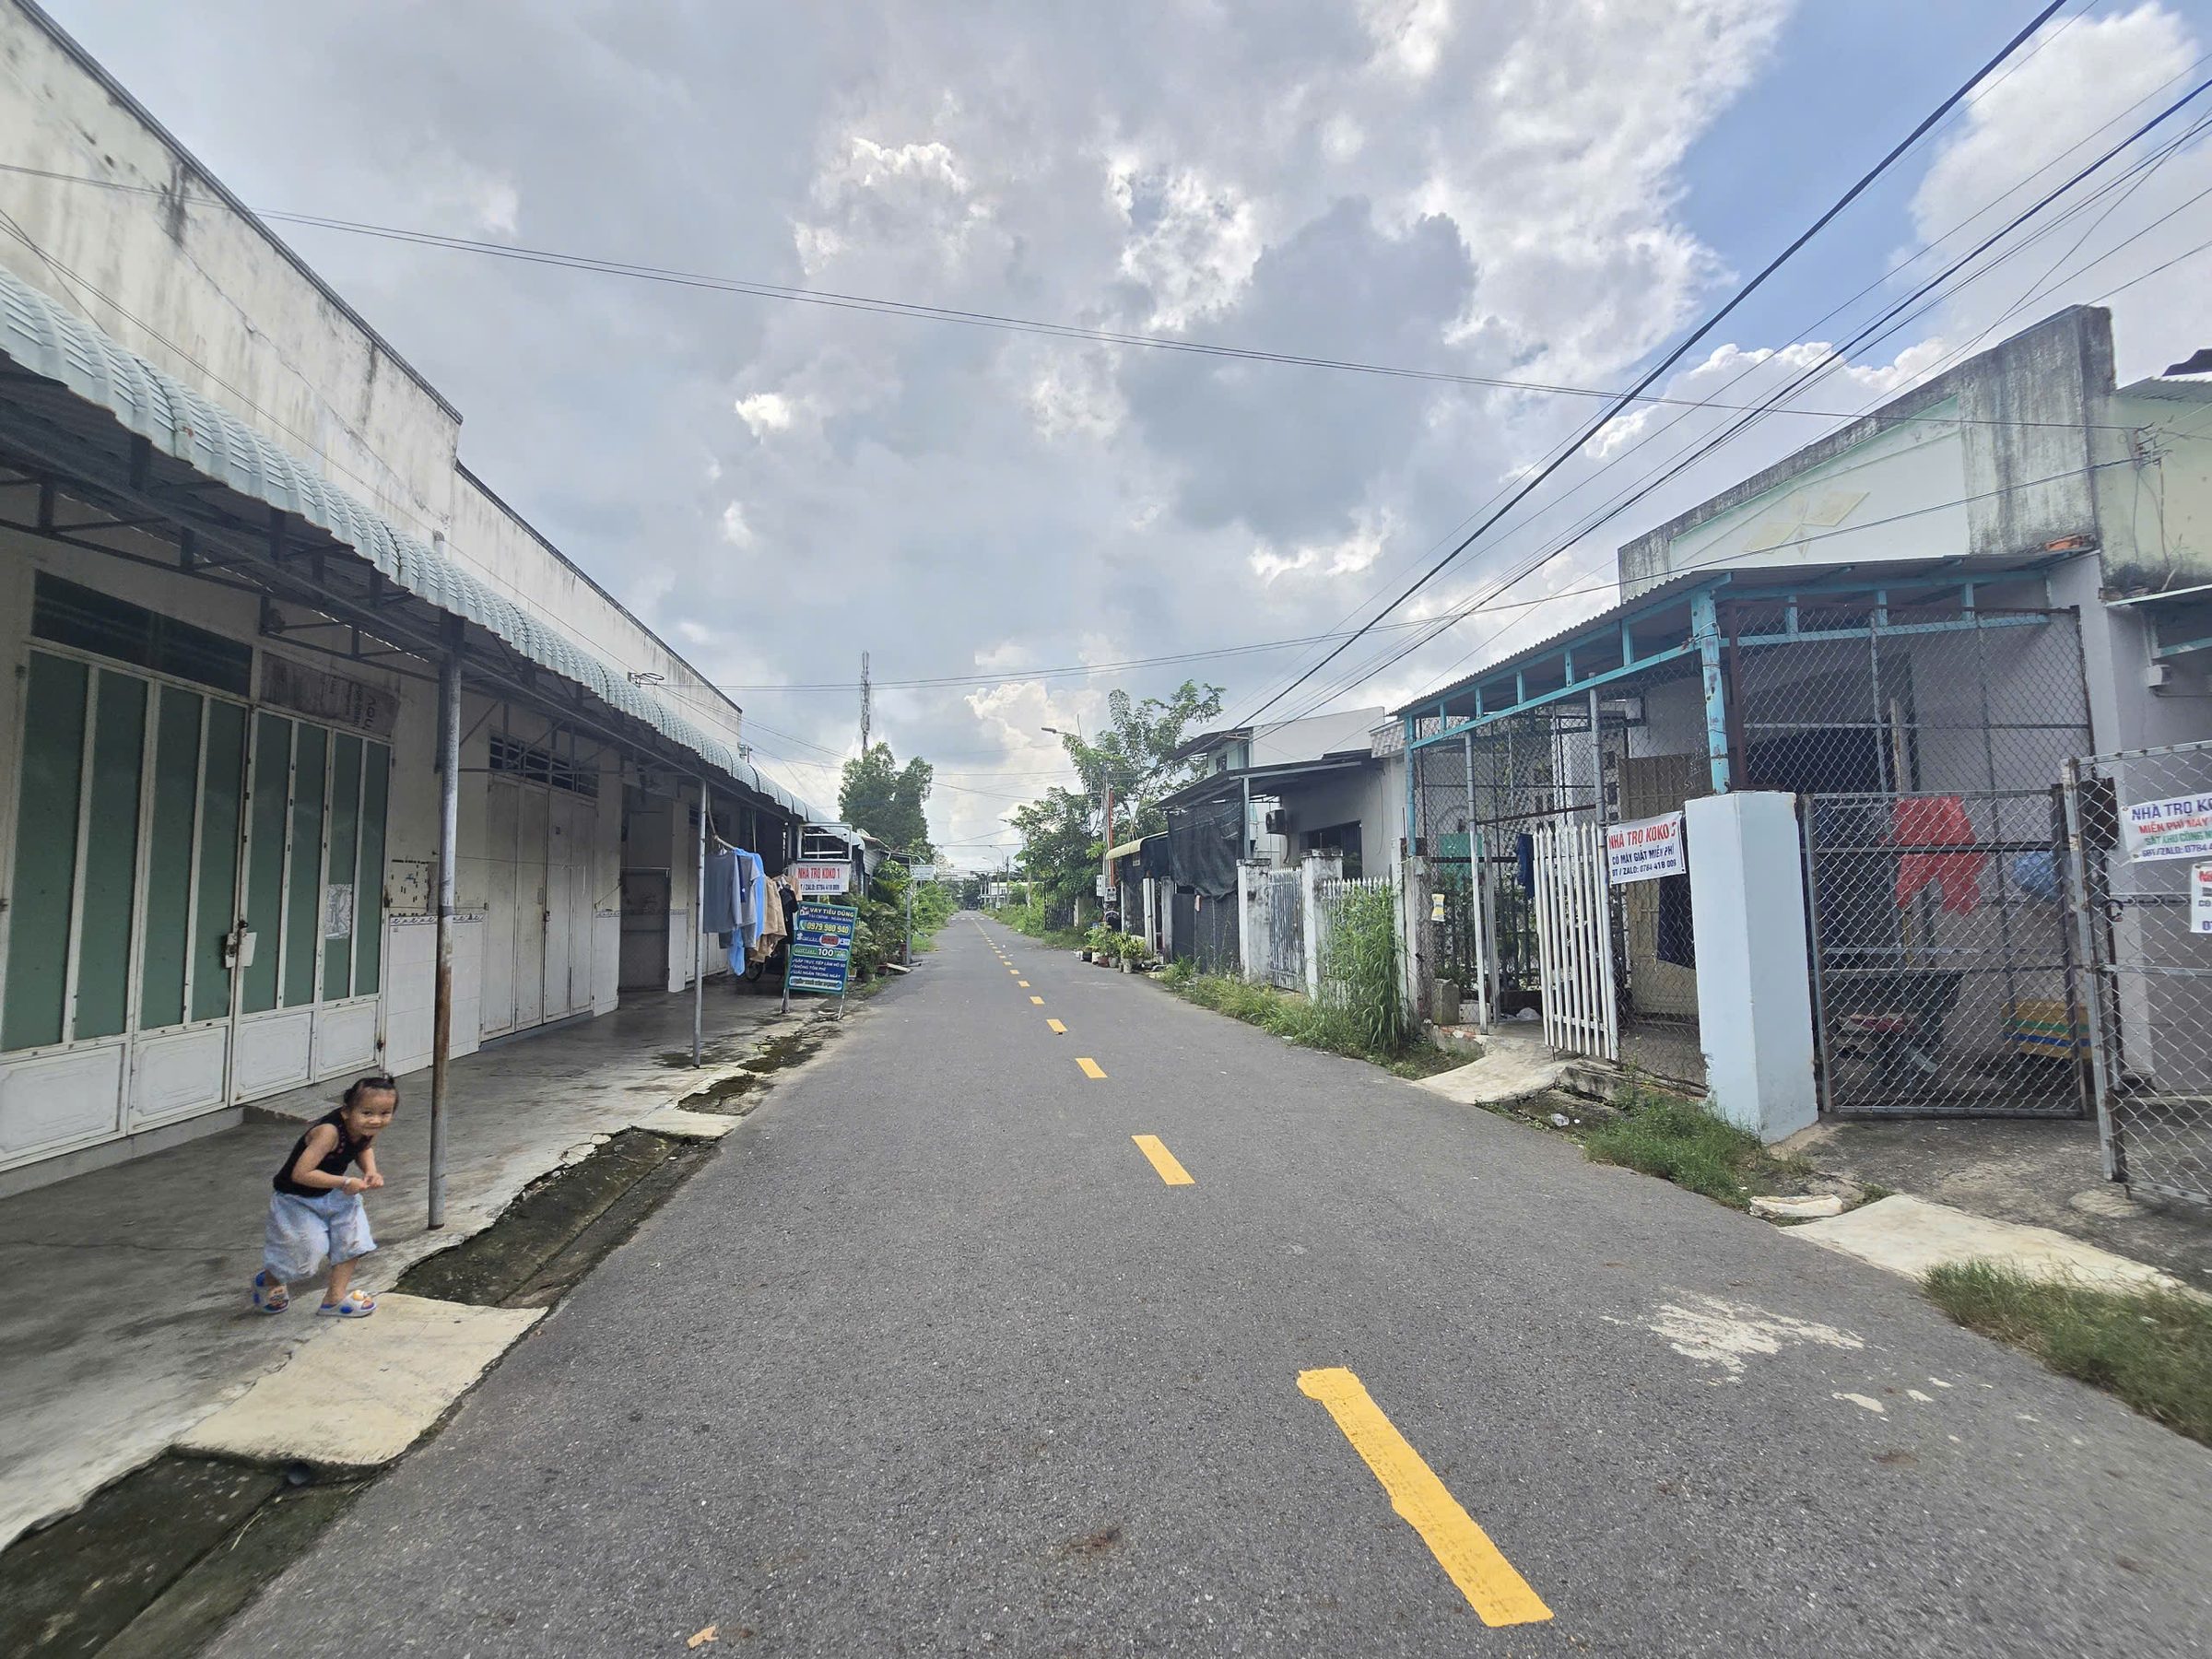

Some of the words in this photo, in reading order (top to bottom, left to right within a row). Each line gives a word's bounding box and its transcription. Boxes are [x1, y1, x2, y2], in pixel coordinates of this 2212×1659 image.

[2132, 804, 2161, 820] NHÀ
[2163, 801, 2193, 817] TRỌ
[1608, 830, 1625, 850] NHÀ
[1627, 829, 1643, 847] TRỌ
[1646, 824, 1669, 842] KOKO
[2184, 844, 2206, 853] 0784
[1612, 854, 1619, 865] CÓ
[822, 868, 835, 878] KOKO
[837, 868, 840, 878] 1
[806, 922, 823, 931] 0979
[837, 925, 849, 934] 940
[818, 948, 833, 957] 100
